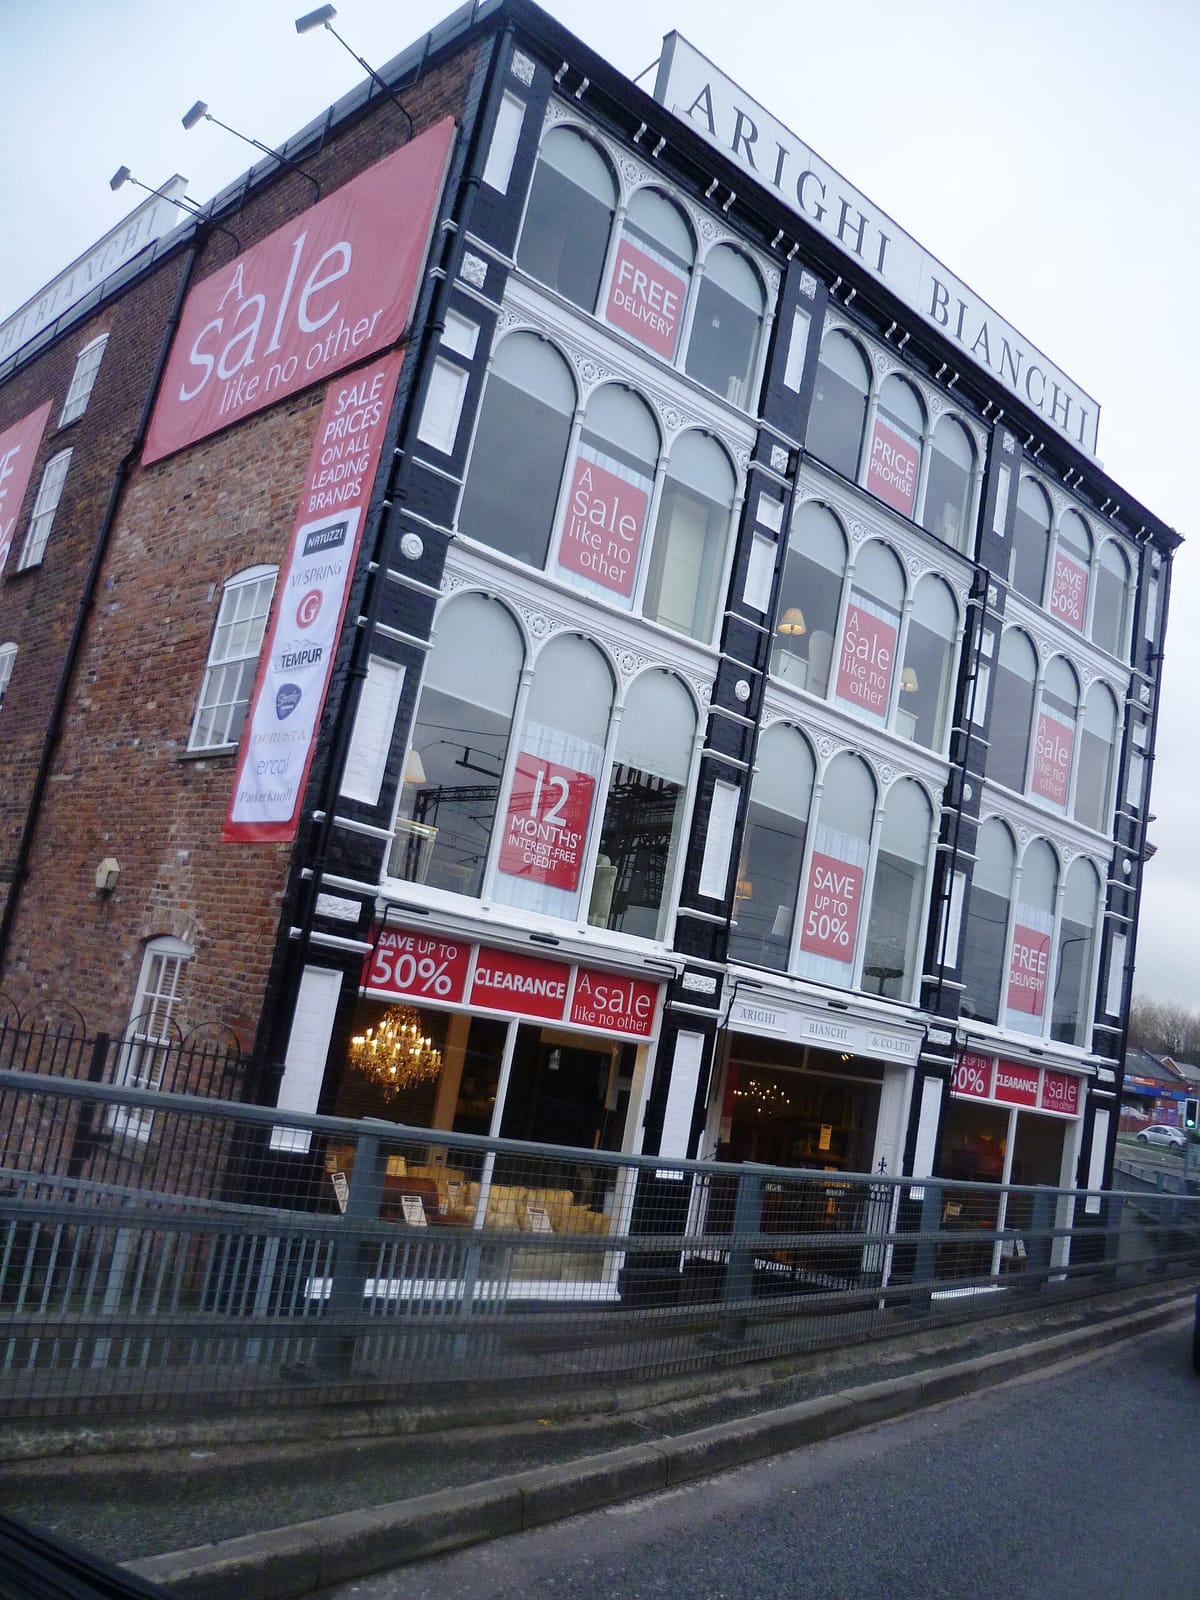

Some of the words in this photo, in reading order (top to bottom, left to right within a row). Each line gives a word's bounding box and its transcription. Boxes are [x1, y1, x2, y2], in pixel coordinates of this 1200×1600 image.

[684, 83, 891, 278] ARIGHI
[927, 276, 1089, 447] BIANCHI
[217, 264, 244, 312] A
[618, 259, 679, 321] FREE
[614, 289, 674, 338] DELIVERY
[218, 375, 259, 415] like
[265, 356, 298, 391] no
[306, 309, 383, 370] other
[335, 373, 384, 415] SALE
[323, 401, 382, 445] PRICES
[322, 444, 343, 465] ON
[345, 433, 369, 456] ALL
[873, 436, 914, 481] PRICE
[311, 454, 369, 489] LEADING
[578, 467, 593, 491] A
[870, 458, 911, 497] PROMISE
[309, 478, 362, 513] BRANDS
[308, 528, 343, 547] NATUZZI
[569, 515, 602, 550] like
[608, 541, 631, 564] no
[580, 551, 626, 583] other
[1055, 561, 1082, 591] SAVE
[1051, 589, 1079, 620] 50%
[1056, 578, 1067, 592] UP
[1068, 587, 1078, 600] TO
[300, 595, 319, 623] G
[848, 612, 859, 632] A
[281, 648, 322, 668] TEMPUR
[842, 652, 866, 680] like
[869, 671, 886, 689] no
[850, 681, 883, 706] other
[257, 752, 291, 775] ercol
[1053, 768, 1065, 783] no
[530, 770, 570, 827] 12
[523, 852, 559, 871] CREDIT
[813, 867, 855, 899] SAVE
[815, 894, 829, 910] UP
[832, 899, 848, 917] TO
[806, 910, 849, 946] 50%
[378, 931, 415, 952] SAVE
[418, 939, 436, 955] UP
[439, 944, 458, 960] TO
[1011, 943, 1047, 975] FREE
[371, 949, 452, 995] 50%
[474, 967, 566, 1000] CLEARANCE
[577, 974, 592, 994] A
[1009, 970, 1045, 992] DELIVERY
[574, 1004, 596, 1023] like
[599, 1013, 615, 1026] no
[617, 1015, 648, 1032] other
[740, 1008, 777, 1025] ARIGHI
[809, 1023, 848, 1040] BIANCHI
[880, 1038, 893, 1049] CO
[895, 1041, 911, 1053] LTD
[996, 1073, 1038, 1093] CLEARANCE
